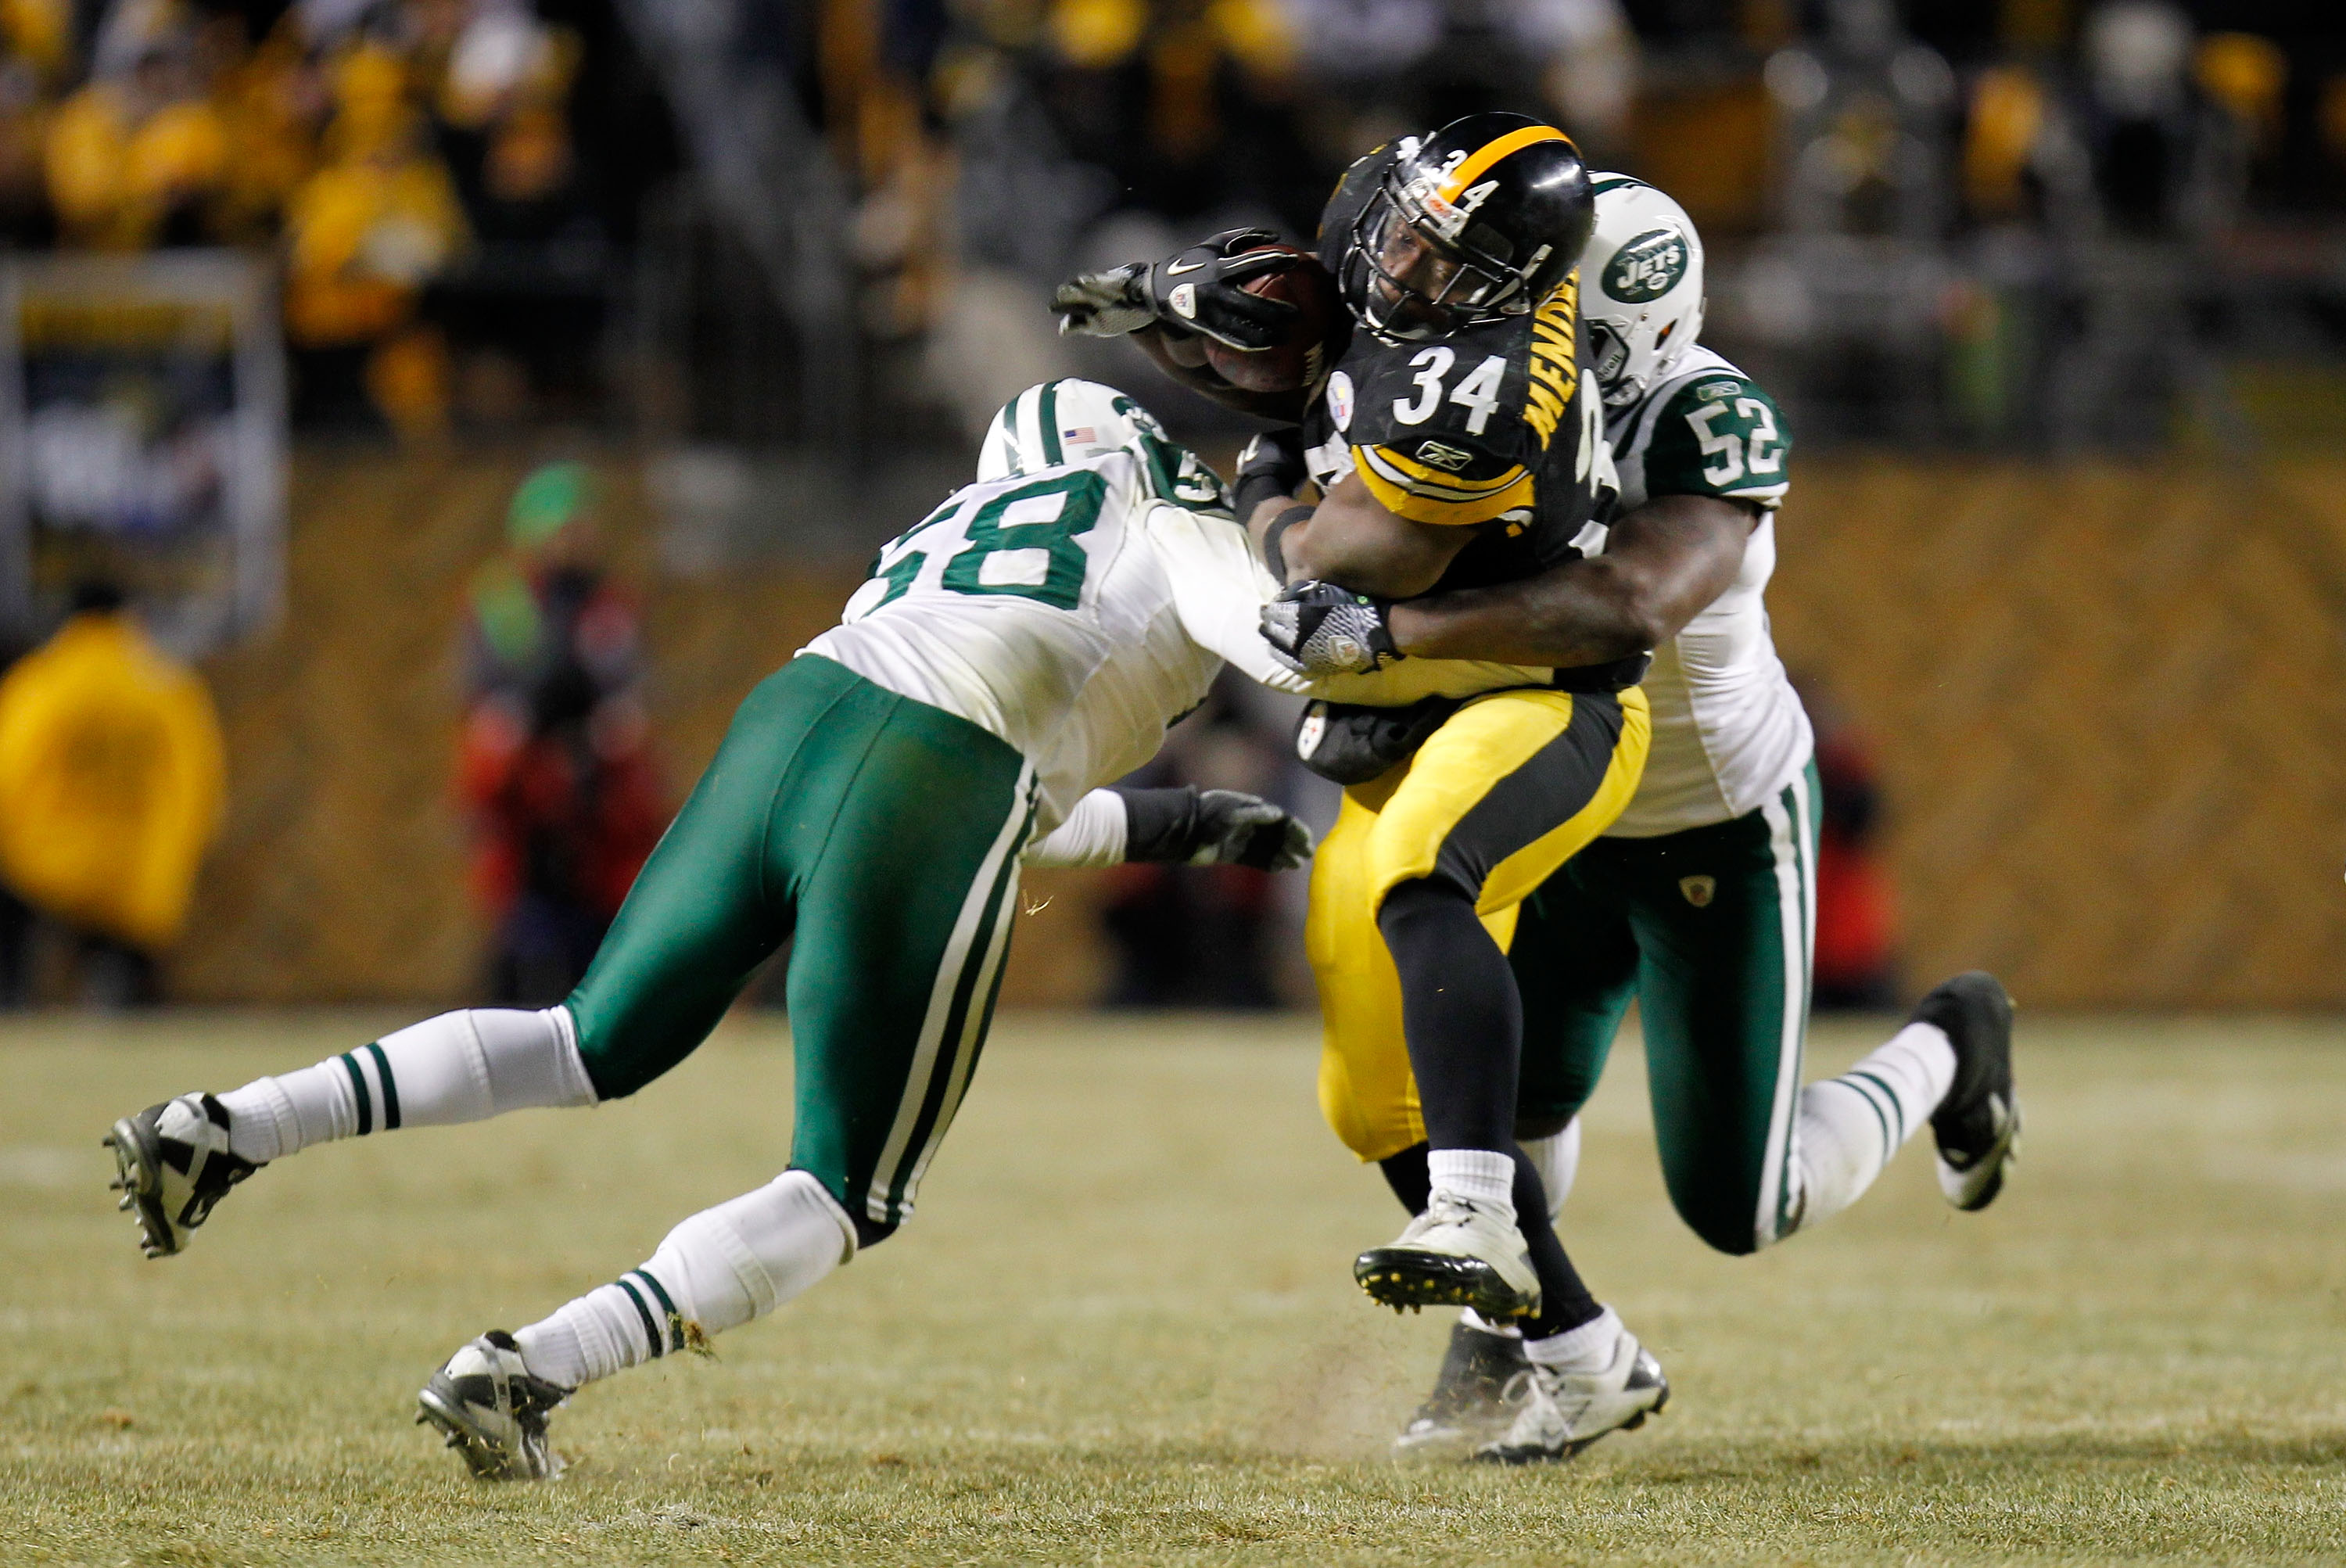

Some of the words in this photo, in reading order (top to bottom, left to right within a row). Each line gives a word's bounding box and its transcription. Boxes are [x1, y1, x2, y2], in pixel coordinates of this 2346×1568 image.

[1616, 244, 1681, 289] JETS
[1393, 346, 1508, 436] 34
[1684, 396, 1785, 486] 52
